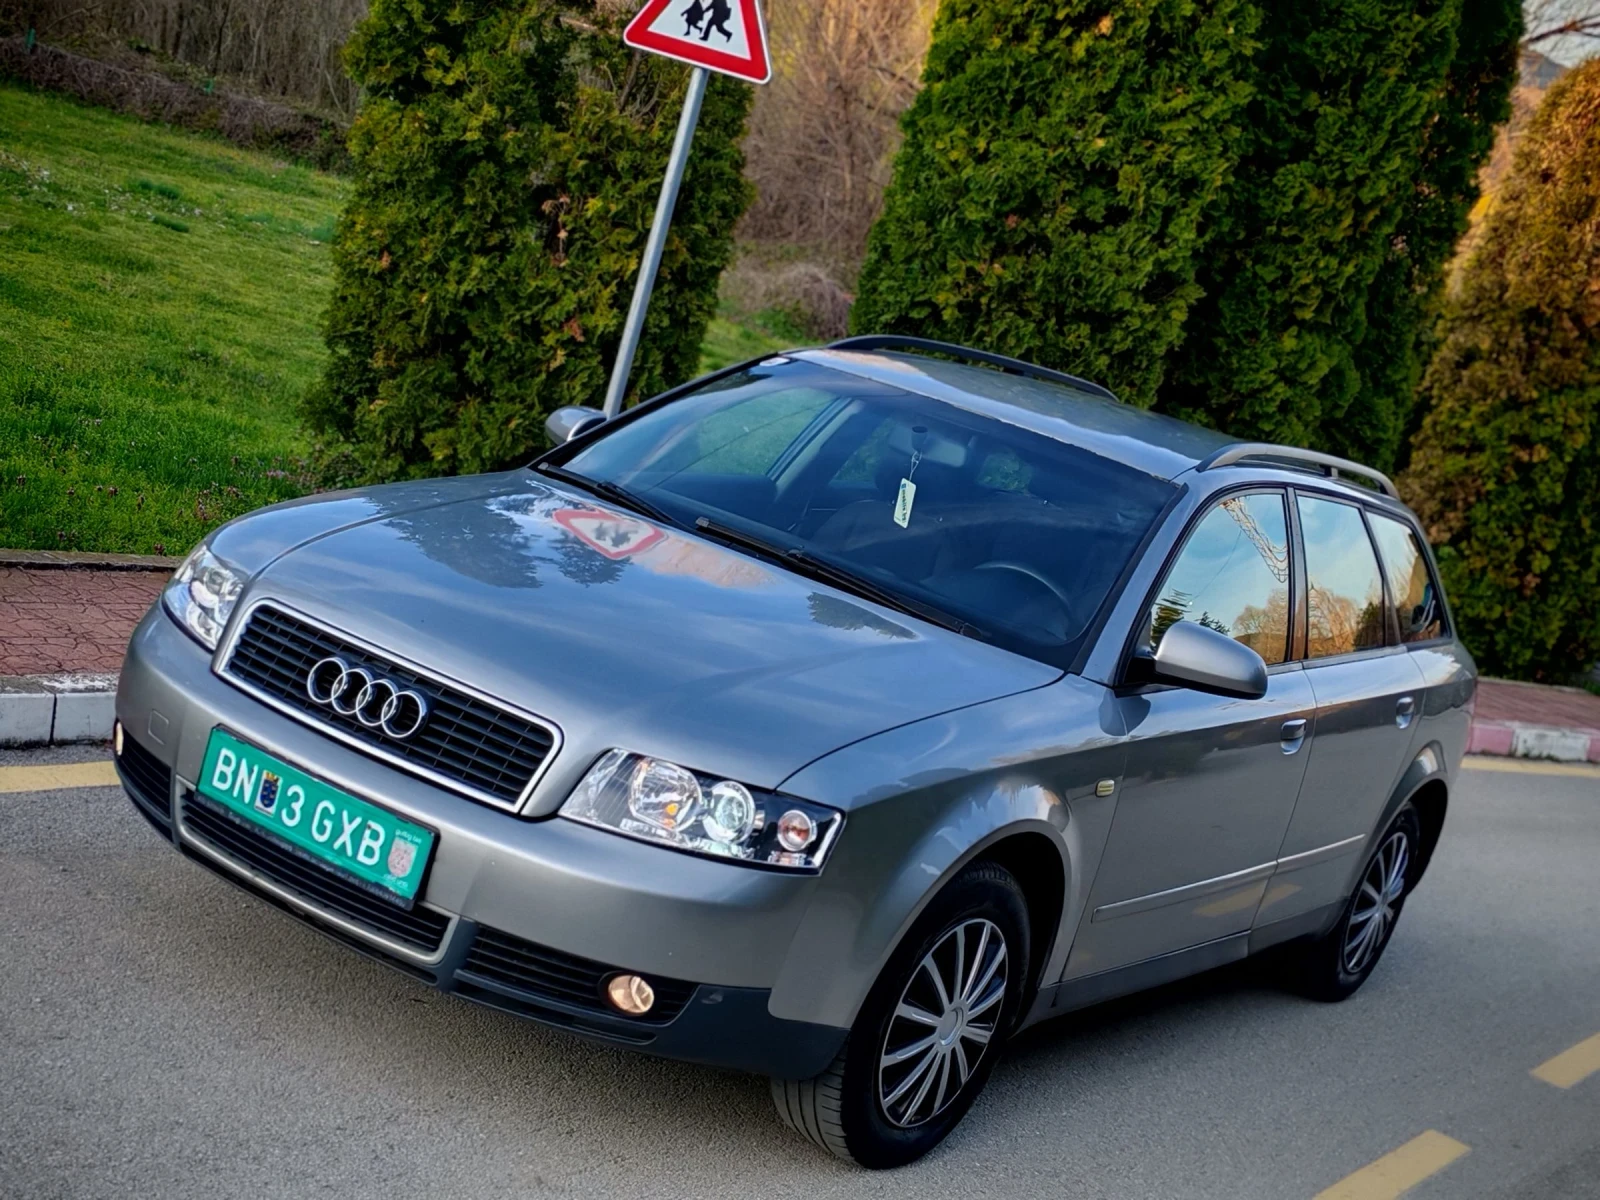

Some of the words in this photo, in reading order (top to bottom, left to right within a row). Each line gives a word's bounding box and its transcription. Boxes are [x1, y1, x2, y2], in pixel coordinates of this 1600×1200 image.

[211, 747, 259, 805] BN
[281, 784, 306, 828] 3
[311, 799, 386, 866] GXB
